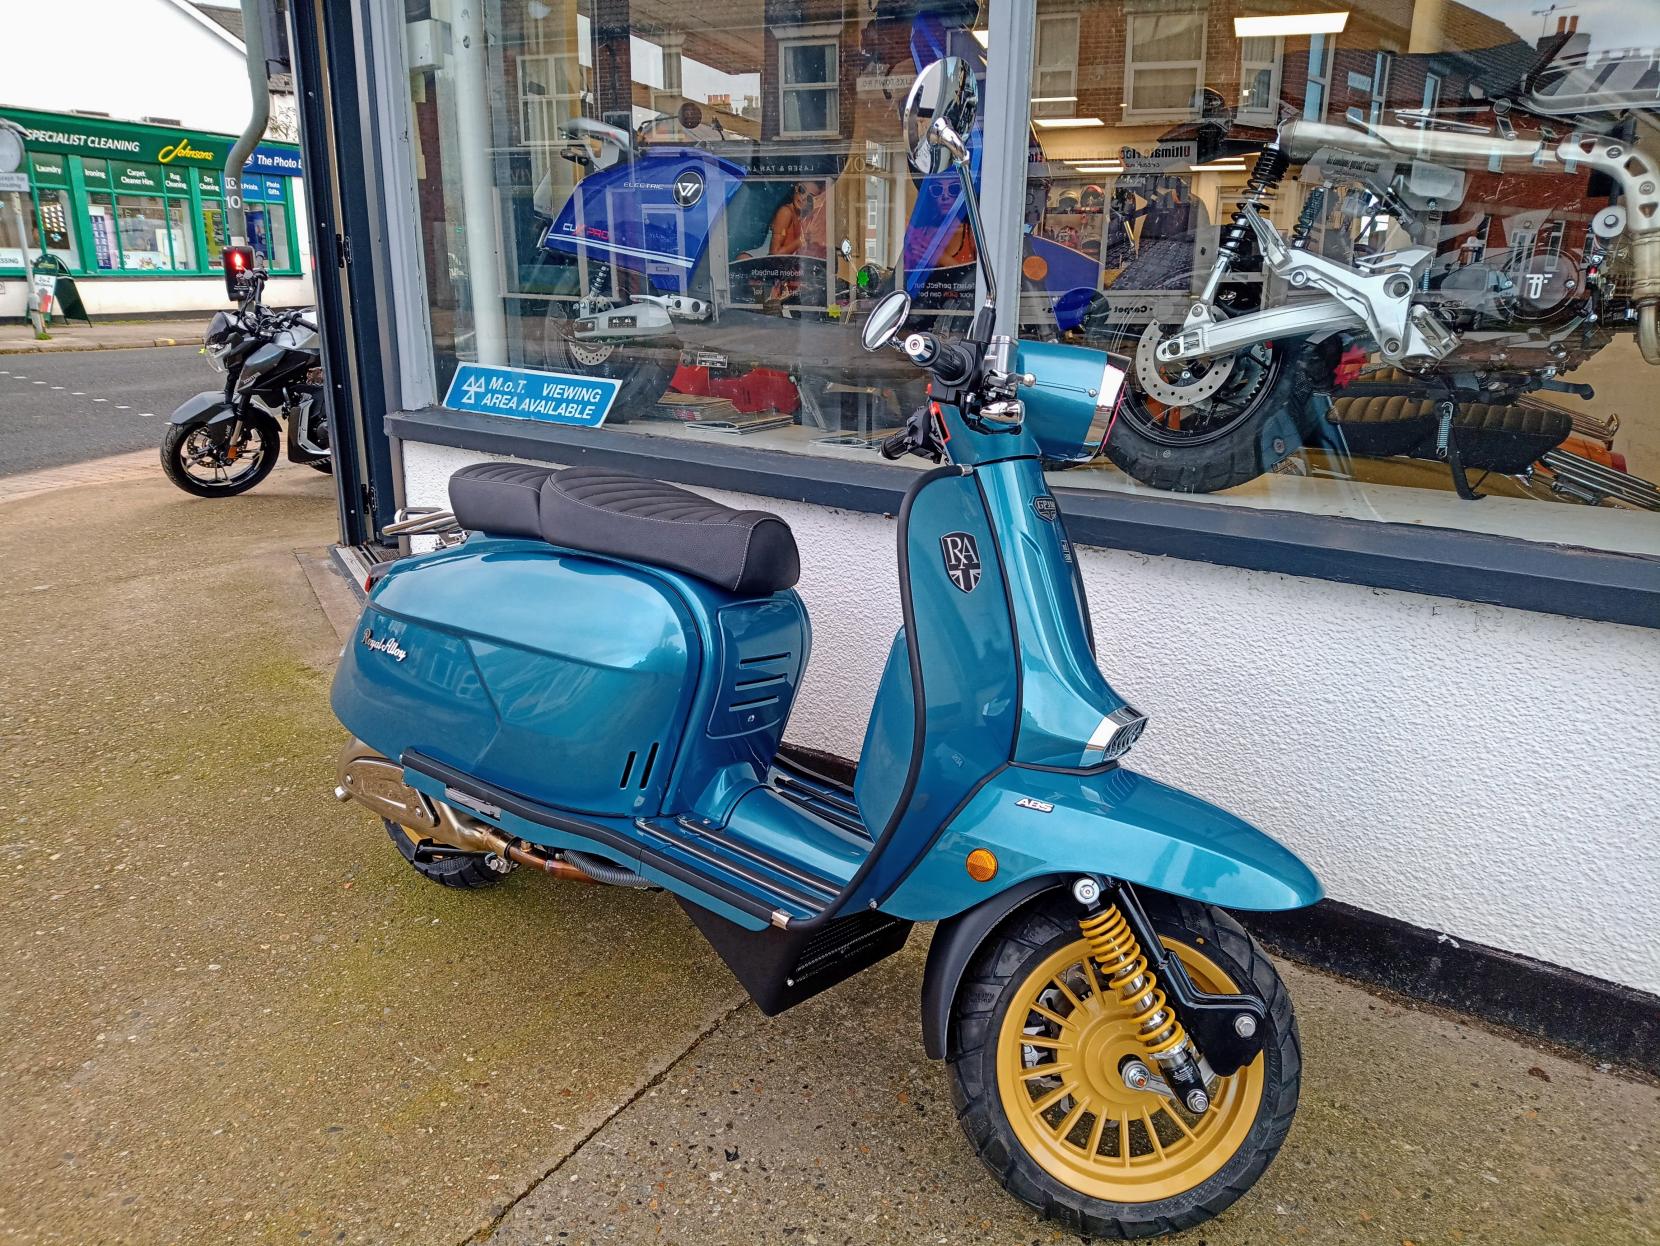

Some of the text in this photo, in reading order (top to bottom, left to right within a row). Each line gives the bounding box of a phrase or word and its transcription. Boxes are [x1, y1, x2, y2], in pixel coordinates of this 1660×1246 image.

[25, 129, 140, 152] SPECIALIST CLEANING
[158, 138, 215, 164] Johnsons
[257, 154, 272, 165] The
[273, 156, 297, 168] Photo
[35, 164, 62, 175] Laundry
[84, 168, 106, 179] Ironing
[126, 168, 146, 178] Carpet
[121, 176, 141, 184] Cleaner
[623, 181, 664, 190] ELECTRIC
[226, 195, 241, 209] 10
[488, 376, 602, 403] M.o.T. VIEWING
[481, 393, 596, 419] AREA AVAILABLE
[944, 537, 979, 569] RA
[362, 628, 407, 662] Royal Alloy
[1015, 798, 1054, 812] ABS
